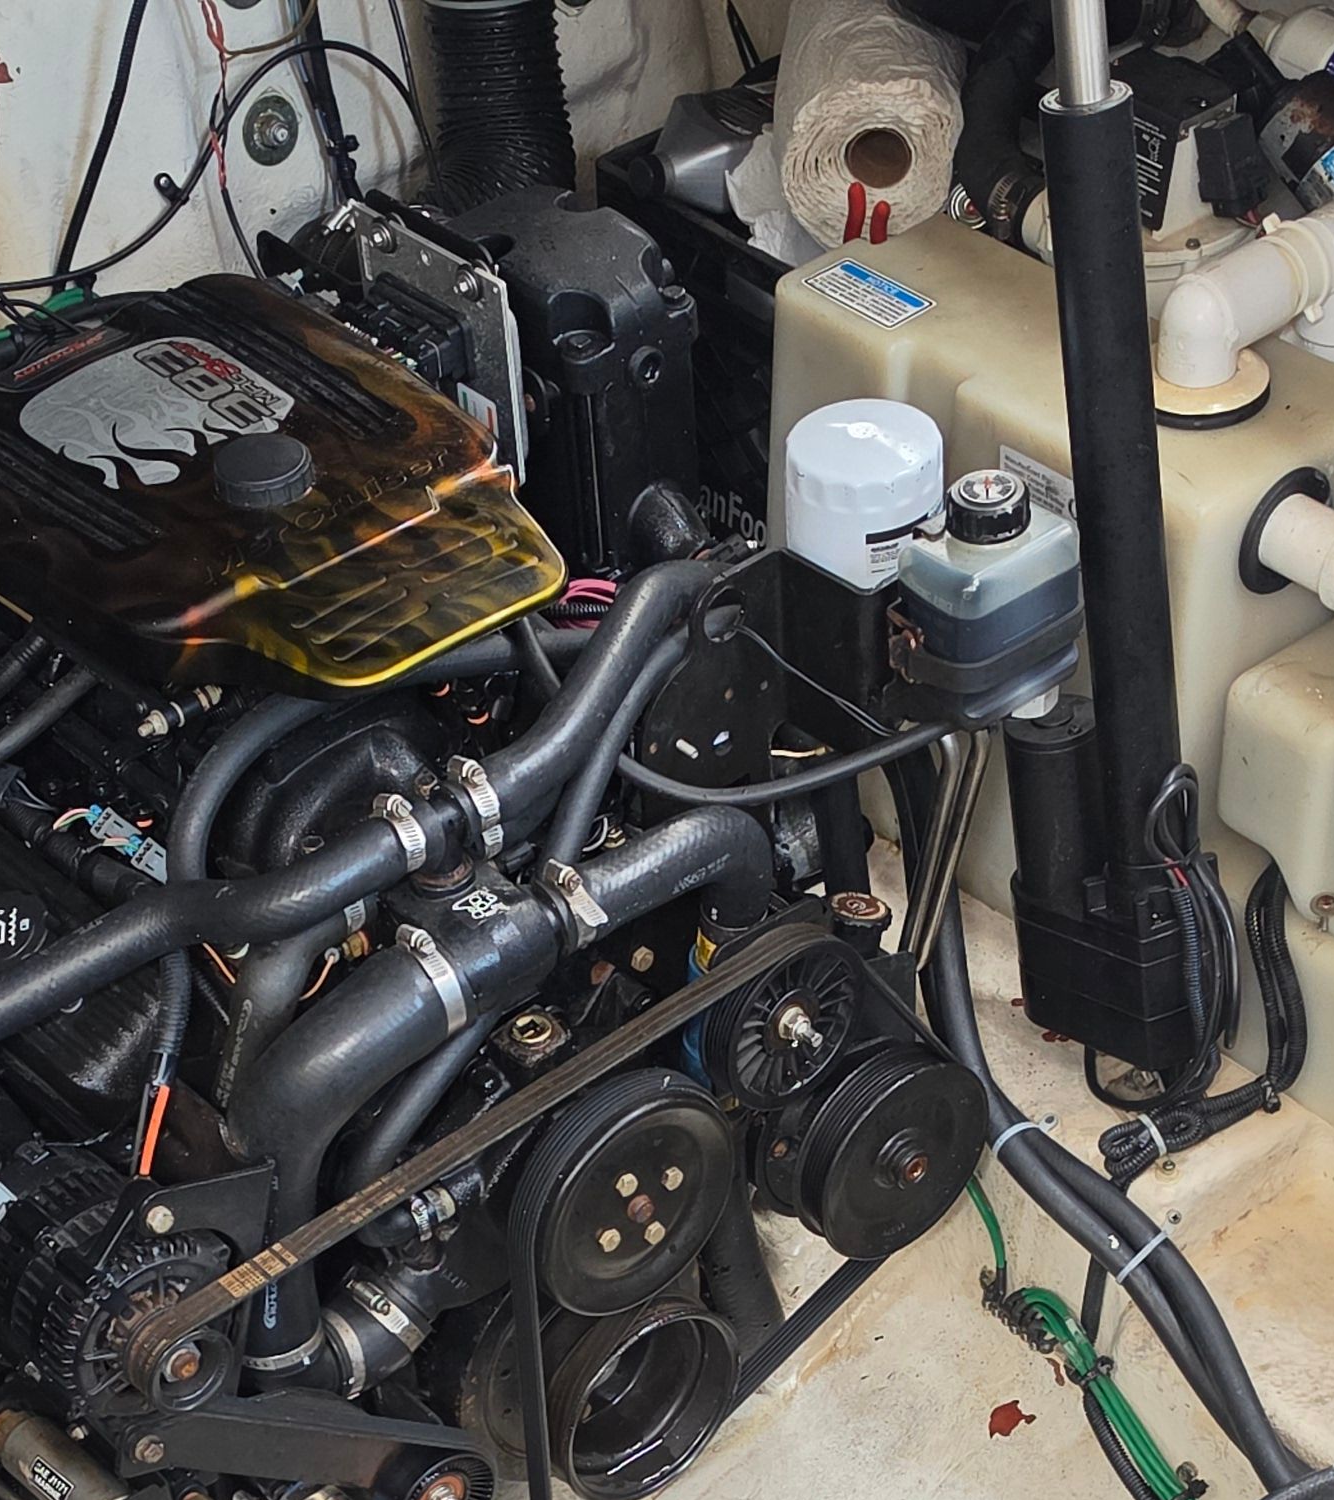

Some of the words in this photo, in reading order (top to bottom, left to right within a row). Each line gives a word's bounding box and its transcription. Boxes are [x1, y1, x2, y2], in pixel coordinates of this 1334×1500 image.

[864, 273, 900, 298] NOTICE
[131, 327, 275, 443] 383
[46, 1472, 71, 1495] J1171
